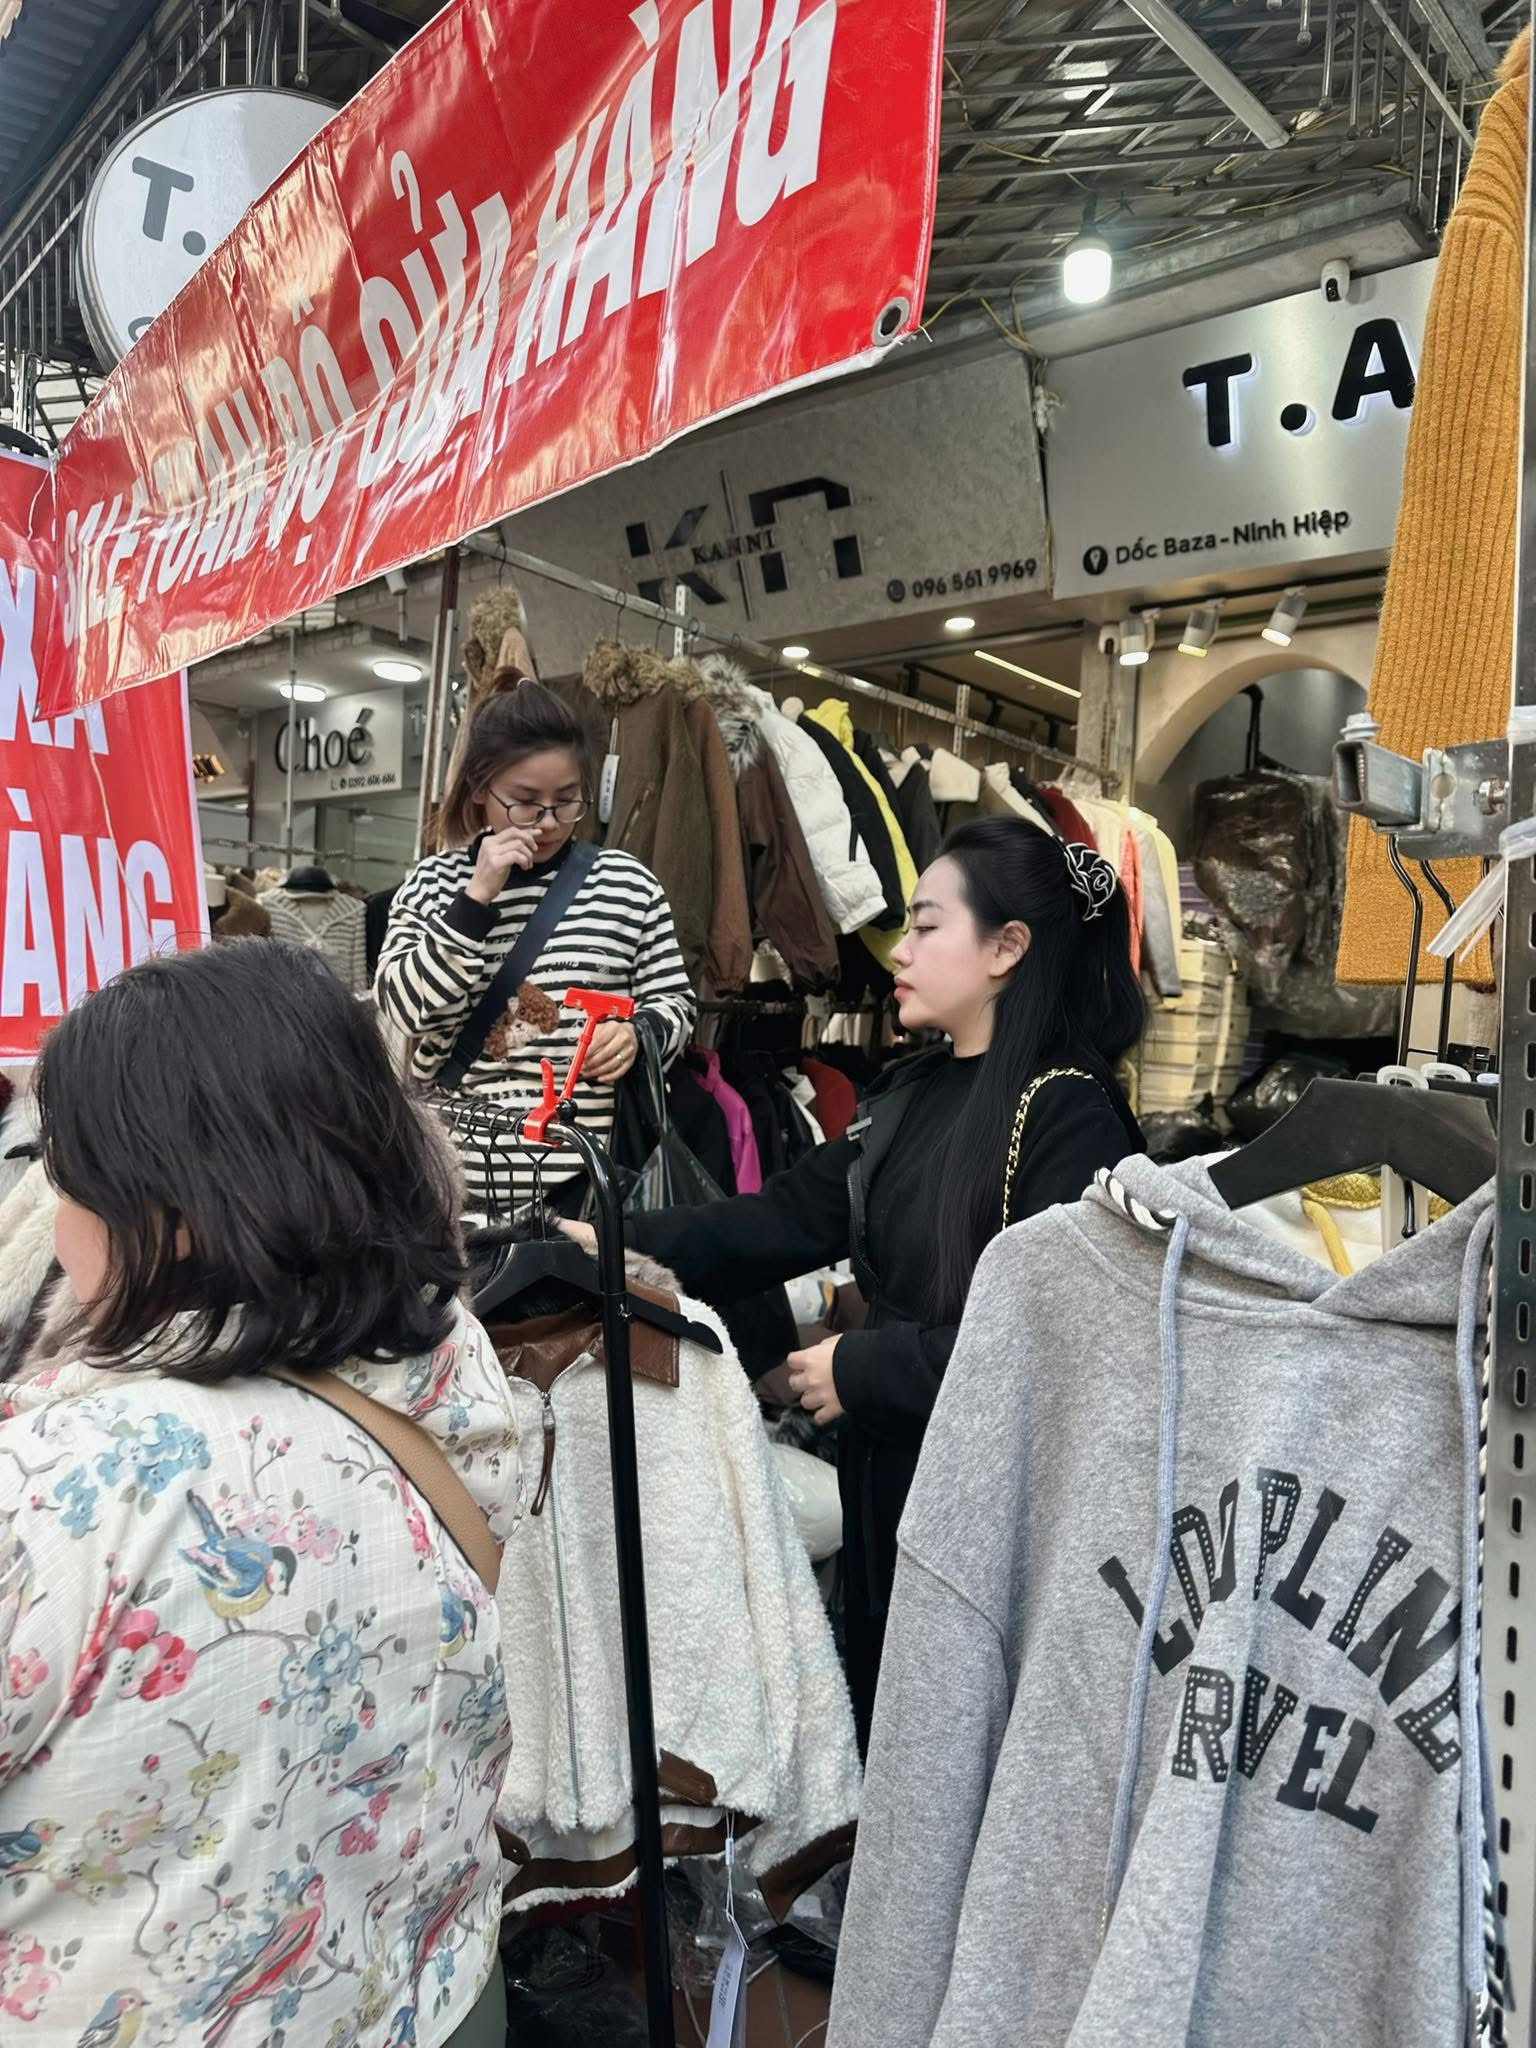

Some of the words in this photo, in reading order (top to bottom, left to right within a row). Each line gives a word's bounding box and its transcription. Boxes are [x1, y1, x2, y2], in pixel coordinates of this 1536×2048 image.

[262, 291, 357, 566] BỘ
[358, 150, 511, 489] CỬA
[504, 0, 837, 388] HÀNG
[692, 530, 776, 566] KANNI
[1115, 536, 1158, 565] Dốc
[1293, 508, 1350, 537] Hiệp
[911, 577, 948, 598] 096
[987, 558, 1037, 585] 9969
[0, 548, 110, 757] X
[274, 707, 375, 775] Choé
